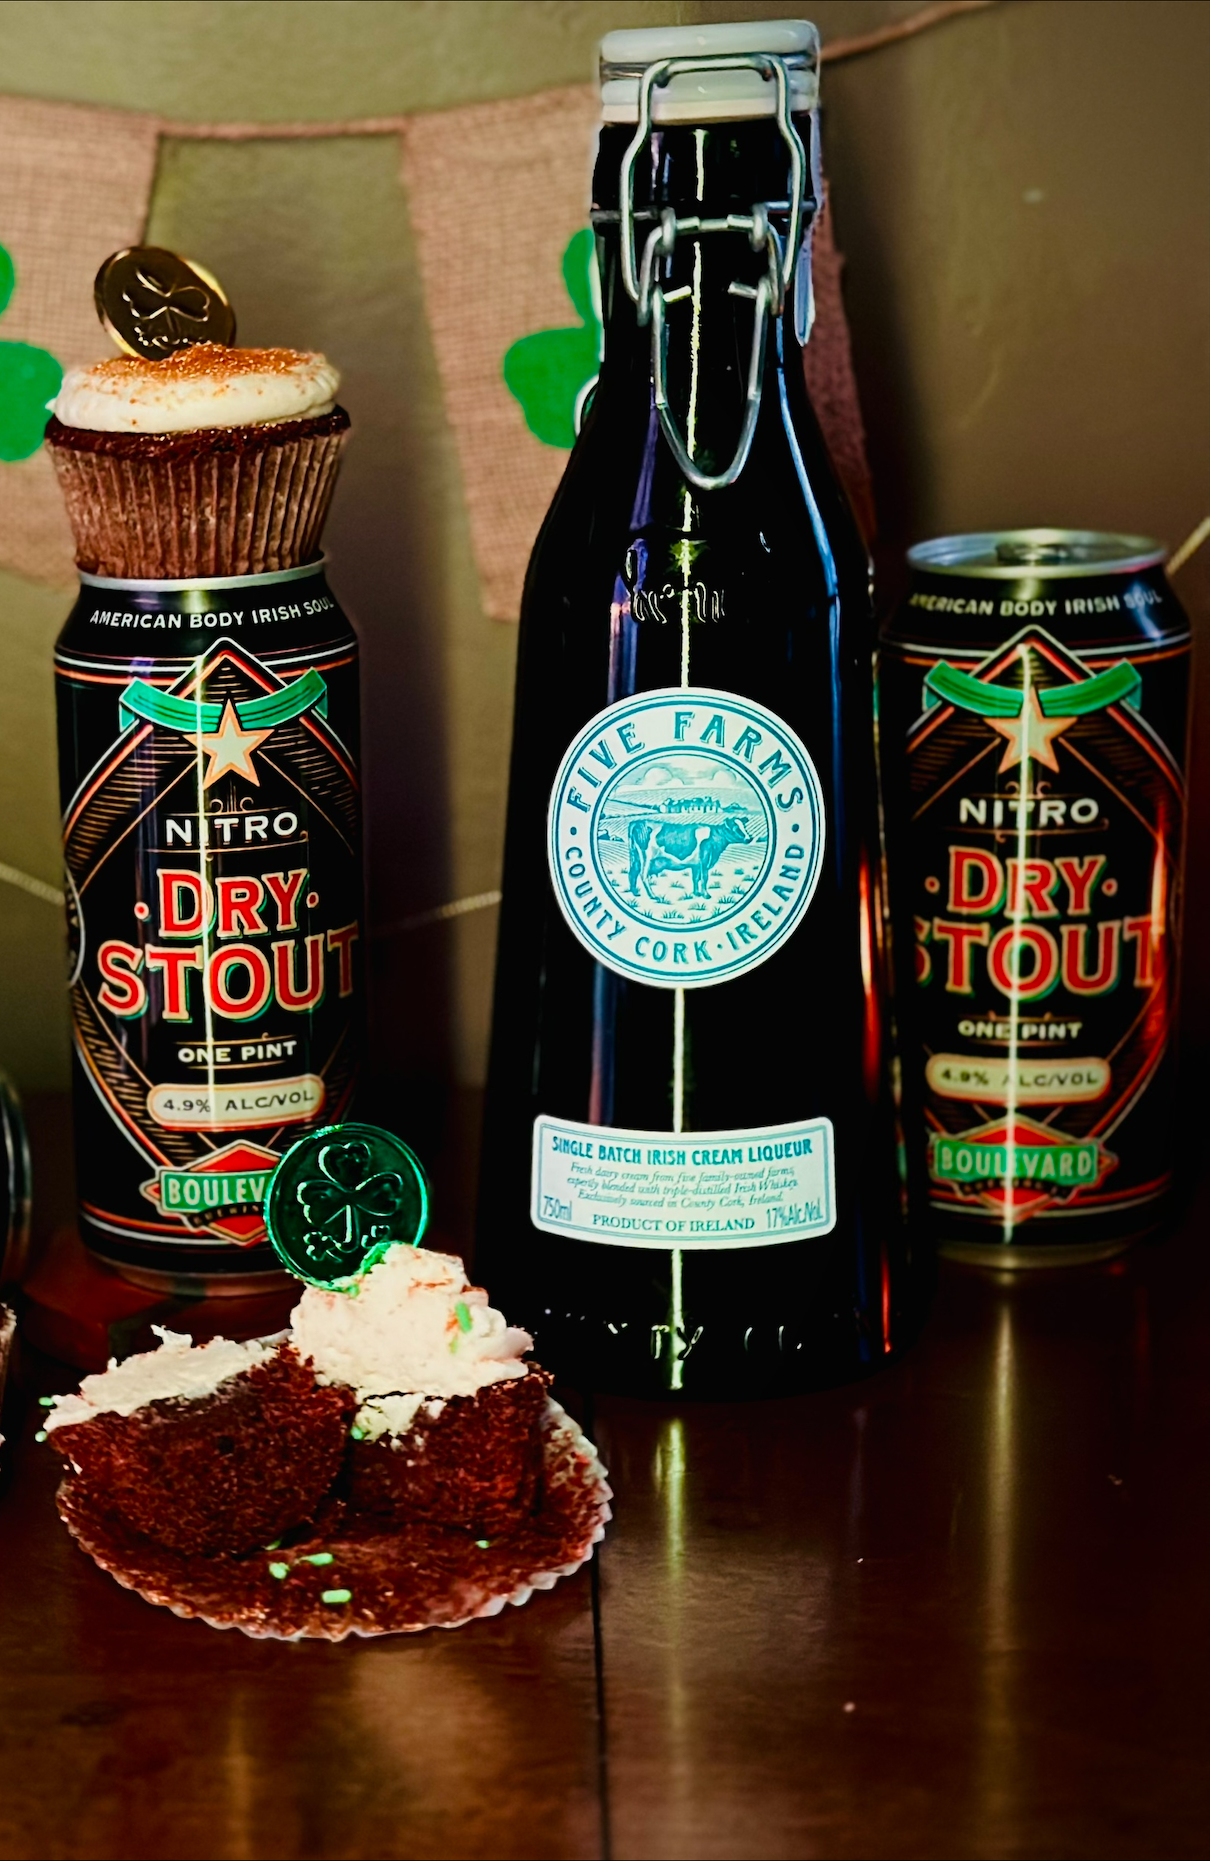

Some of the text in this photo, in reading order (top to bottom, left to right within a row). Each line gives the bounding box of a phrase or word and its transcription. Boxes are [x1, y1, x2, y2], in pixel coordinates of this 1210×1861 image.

[90, 597, 335, 629] AMERICAN BODY IRISH SOUL
[909, 589, 1163, 616] AMERICAN BODY IRISH SOUL
[566, 710, 804, 813] FIVE FARMS
[165, 811, 299, 846] NITRO
[959, 798, 1099, 829] NITRO
[946, 845, 1108, 918] DRY
[156, 867, 310, 940] DRY
[565, 843, 805, 965] COUNTY CORK IRELAND
[96, 921, 360, 1022] STOUT
[957, 1019, 1084, 1040] ONE PINT
[177, 1040, 298, 1063] ONE PINT
[163, 1089, 315, 1114] 4.9% ALC/VOL
[552, 1135, 813, 1166] SINGLE BATCH IRISH CREAM LIQUEUR
[941, 1146, 1093, 1179] BOULEVARD
[566, 1176, 599, 1192] expertly
[601, 1179, 635, 1193] blended
[638, 1183, 660, 1196] with
[662, 1181, 732, 1199] triple-distilled
[734, 1181, 757, 1194] Irish
[571, 1161, 593, 1175] Fresh
[595, 1166, 619, 1183] dairy
[622, 1172, 649, 1182] cream
[650, 1170, 674, 1186] from
[167, 1176, 267, 1208] BOULEV
[543, 1194, 573, 1221] 750ml
[577, 1188, 628, 1209] Exclusively
[629, 1195, 666, 1208] sourced
[666, 1198, 678, 1208] in
[680, 1196, 715, 1212] County
[592, 1213, 756, 1232] PRODUCT OF IRELAND
